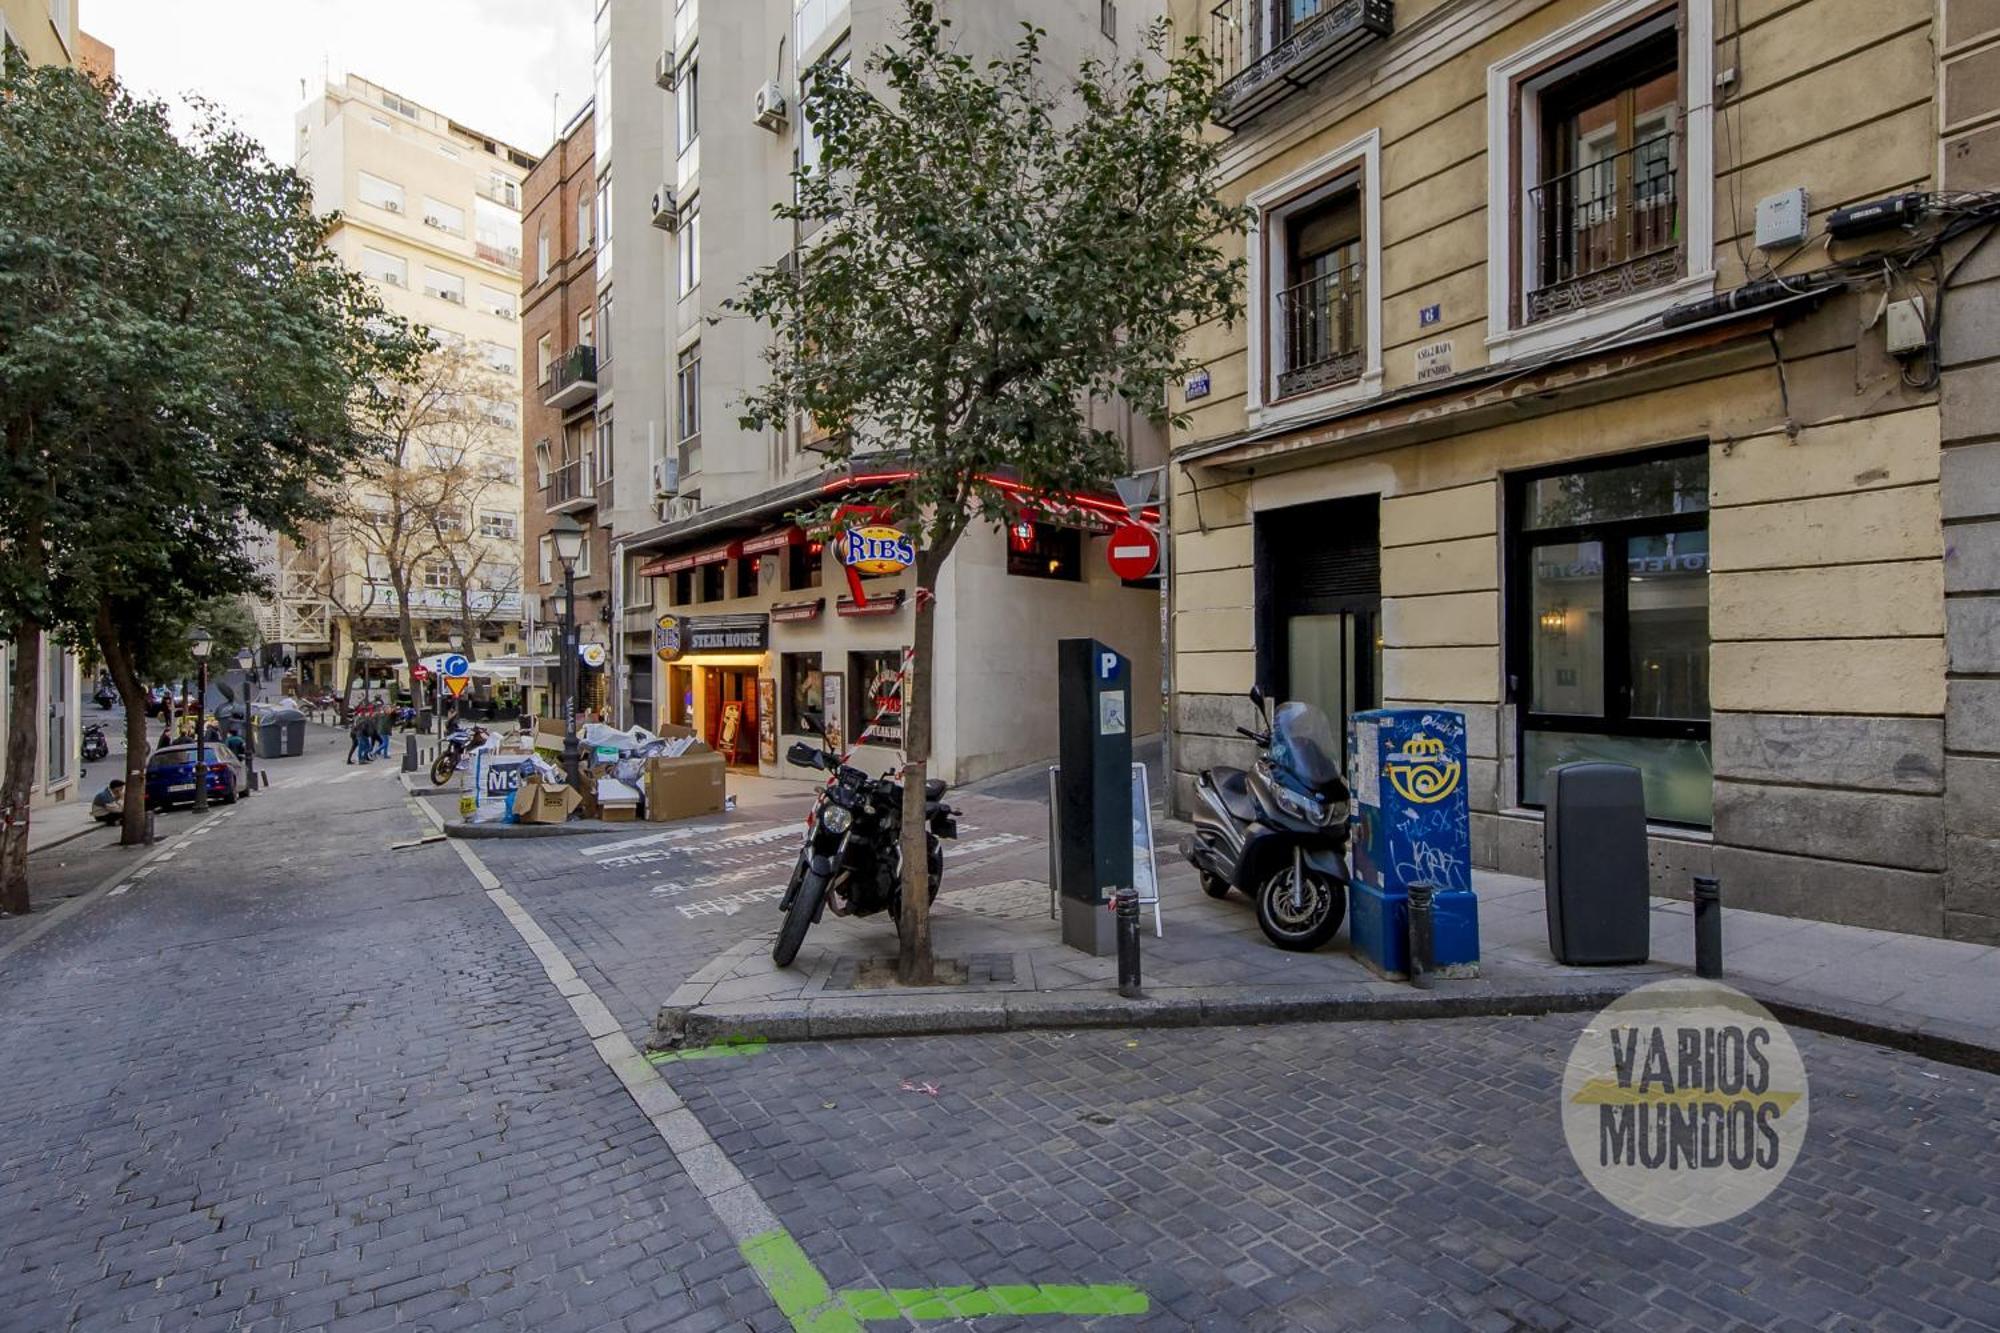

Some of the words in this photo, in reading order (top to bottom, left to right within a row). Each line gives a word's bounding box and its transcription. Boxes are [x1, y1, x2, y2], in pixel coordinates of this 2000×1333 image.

[846, 528, 915, 566] RIBS
[692, 633, 725, 648] STEAK
[725, 632, 760, 647] HOUSE
[1101, 652, 1118, 679] P
